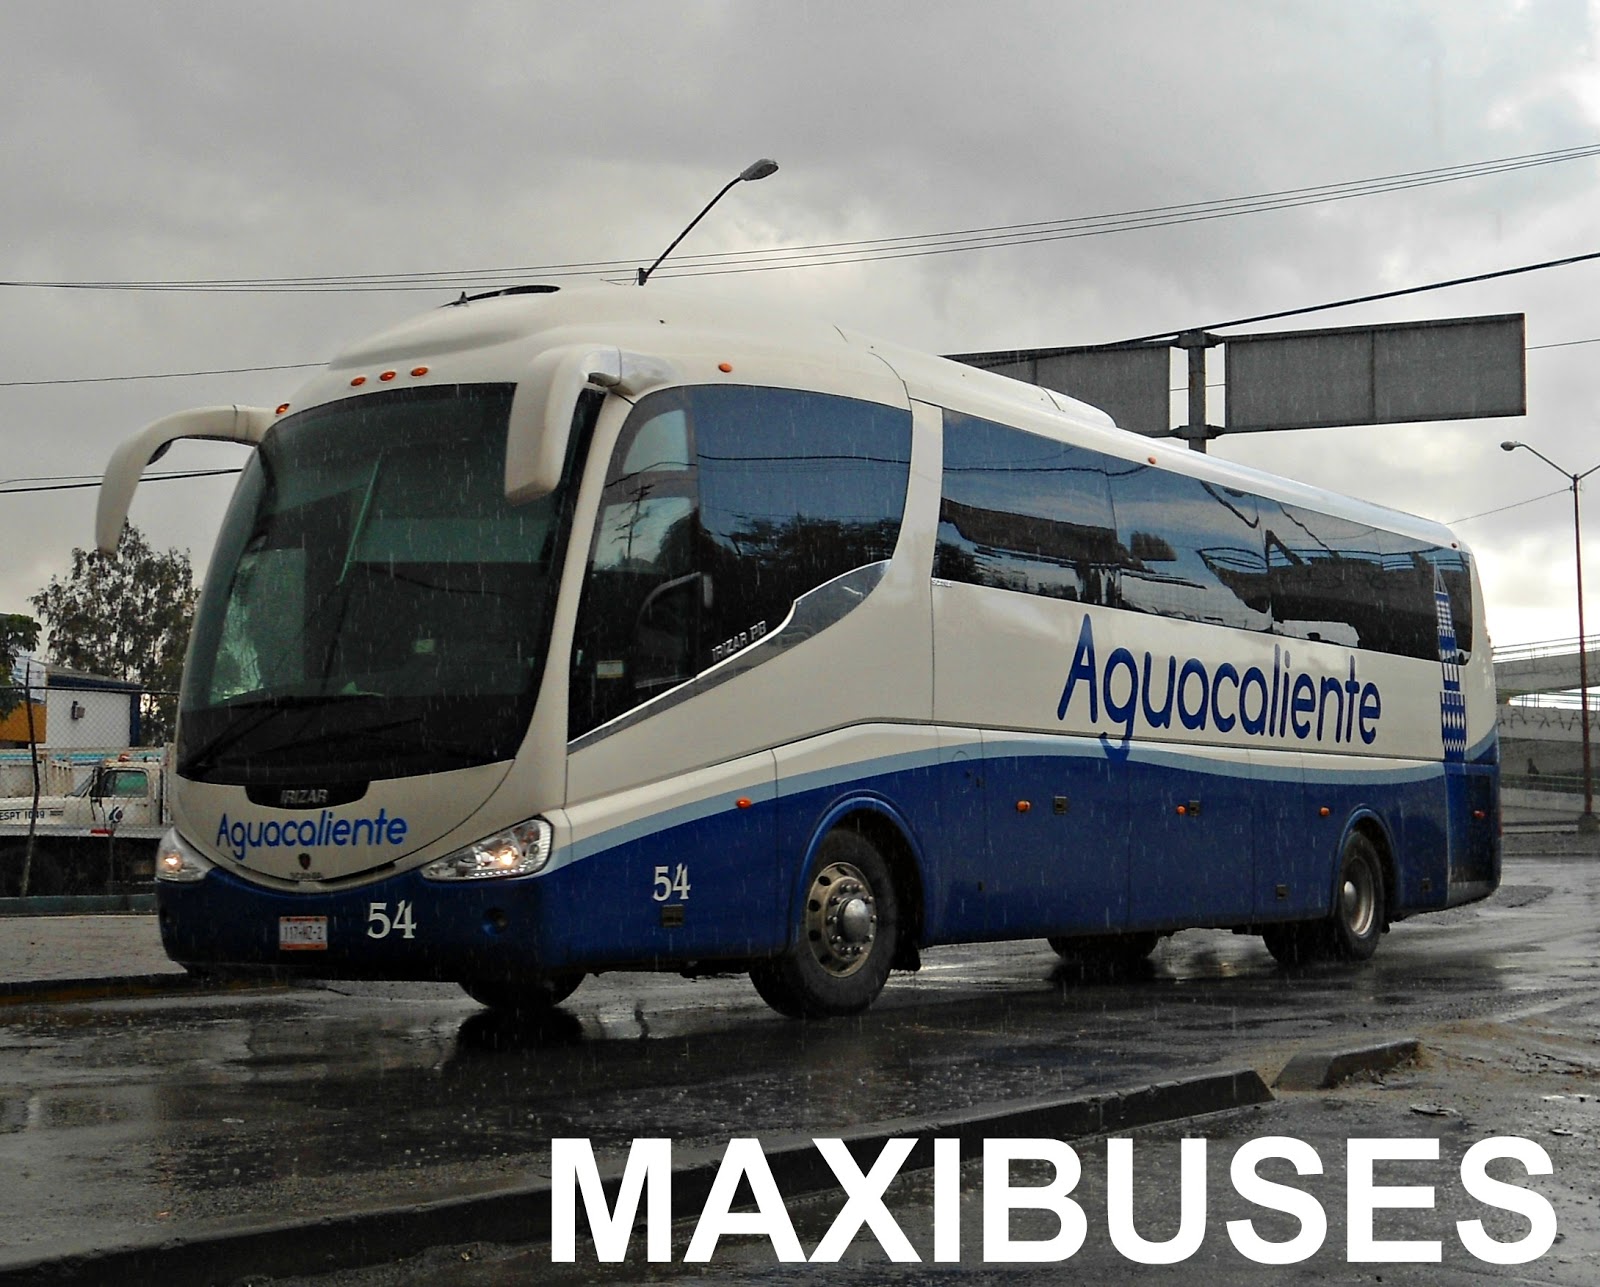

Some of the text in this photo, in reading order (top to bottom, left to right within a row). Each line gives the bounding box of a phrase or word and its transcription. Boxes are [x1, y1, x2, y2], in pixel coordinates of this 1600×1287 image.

[711, 620, 767, 662] IRIZAR PB
[1057, 613, 1382, 764] Aguacaliente
[280, 789, 329, 804] IRIZAR
[216, 808, 408, 861] Aguacaliente
[653, 863, 692, 901] 54
[367, 900, 417, 939] 54
